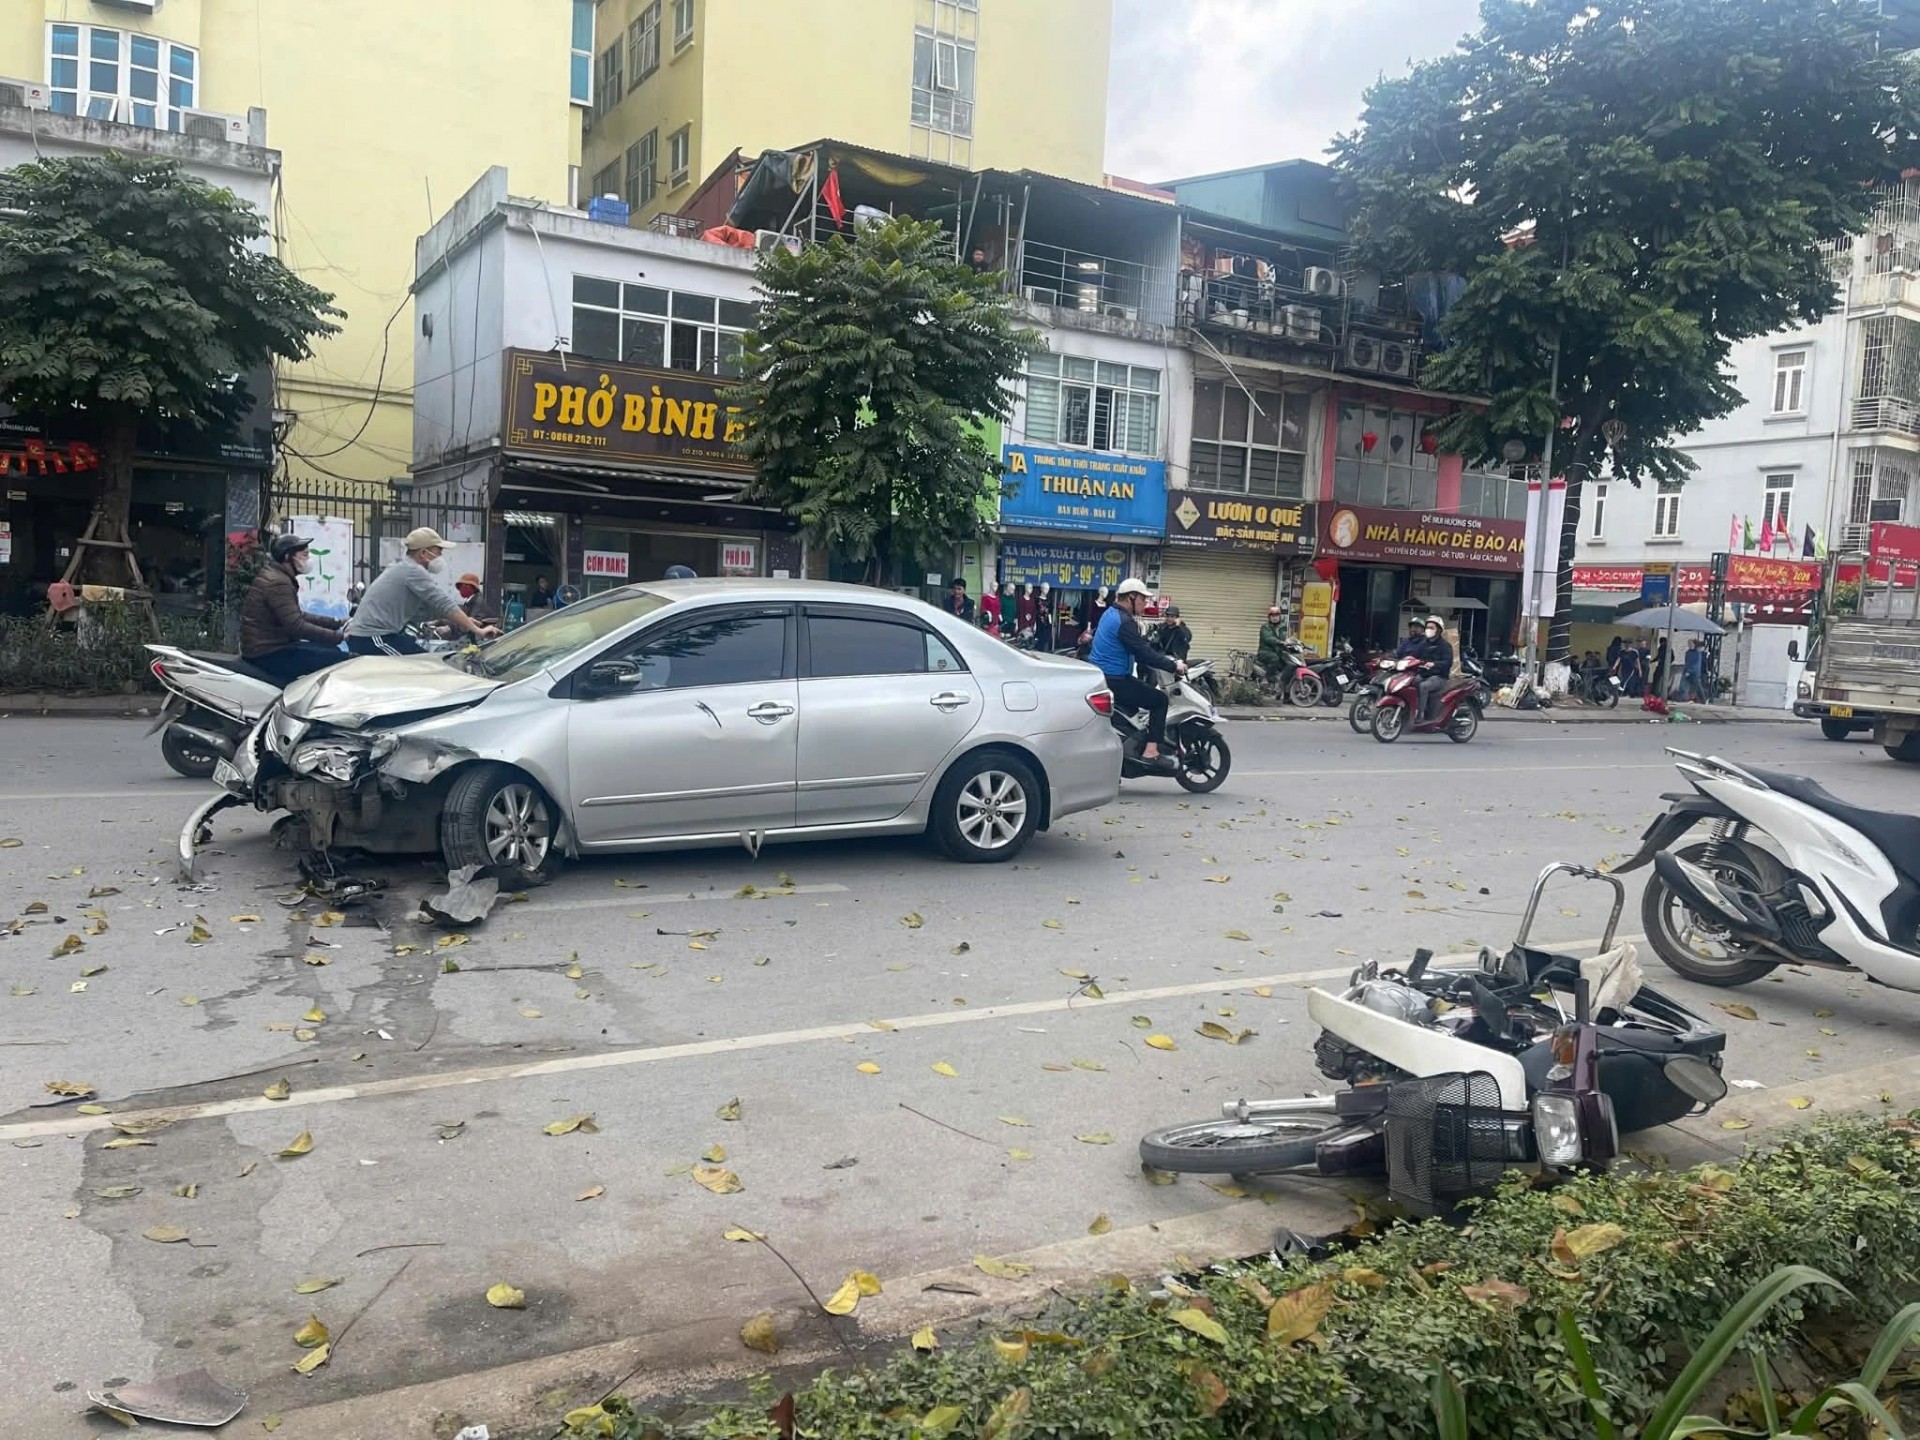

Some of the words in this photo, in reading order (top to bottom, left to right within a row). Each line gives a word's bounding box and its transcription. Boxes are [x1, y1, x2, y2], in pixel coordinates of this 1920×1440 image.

[532, 373, 617, 428] PHỞ
[621, 385, 718, 440] BÌNH
[593, 436, 607, 446] 111
[1008, 451, 1028, 474] TA
[1041, 475, 1105, 499] THUẬN
[1108, 480, 1134, 499] AN
[1255, 506, 1268, 523] O
[1215, 525, 1235, 540] ĐẶC
[1236, 524, 1255, 539] SẢN
[1255, 529, 1280, 544] NGHỆ
[1281, 533, 1294, 543] AN
[1365, 523, 1400, 542] NHÀ
[1404, 524, 1448, 546] HÀNG
[1451, 529, 1472, 548] DÊ
[1474, 530, 1505, 551] BẢO
[586, 555, 604, 572] CƠM
[605, 556, 626, 574] RANG
